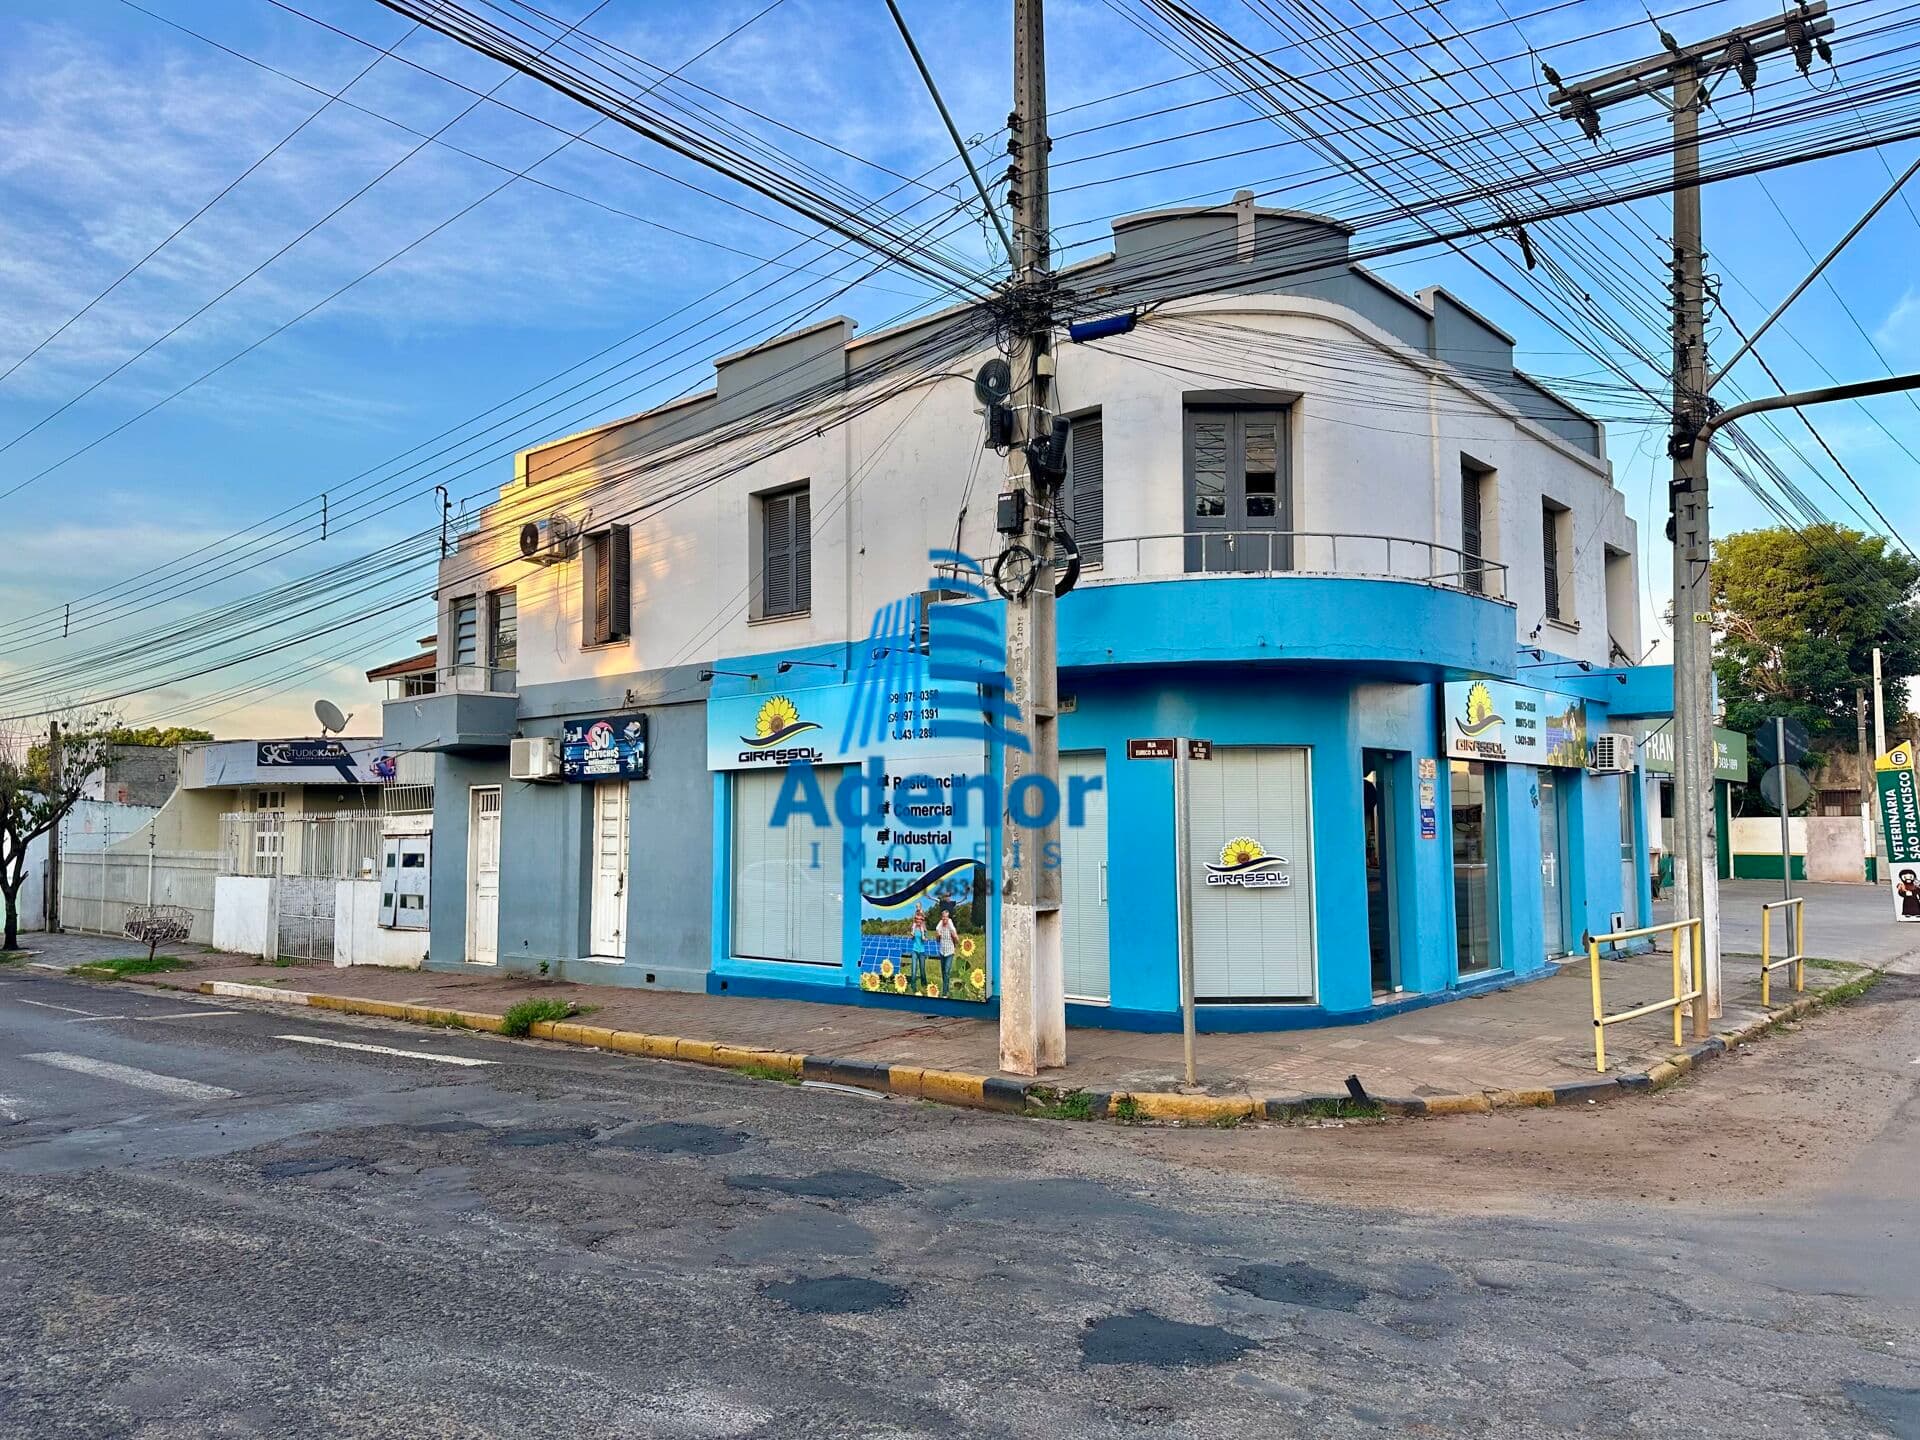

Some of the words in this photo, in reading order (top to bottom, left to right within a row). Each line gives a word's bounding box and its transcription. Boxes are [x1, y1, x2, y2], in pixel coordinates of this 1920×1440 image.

[1455, 738, 1506, 754] GIRASSOL
[738, 747, 823, 763] GIRASSOL
[893, 773, 966, 790] Residencial
[894, 802, 956, 817] Comercial
[1898, 771, 1918, 834] FRANCISCO
[1885, 789, 1905, 861] VETERINÁRIA
[893, 831, 952, 845] Industrial
[1906, 836, 1920, 859] SÃO
[893, 858, 926, 873] Rural
[1207, 872, 1288, 885] GIRASSOL
